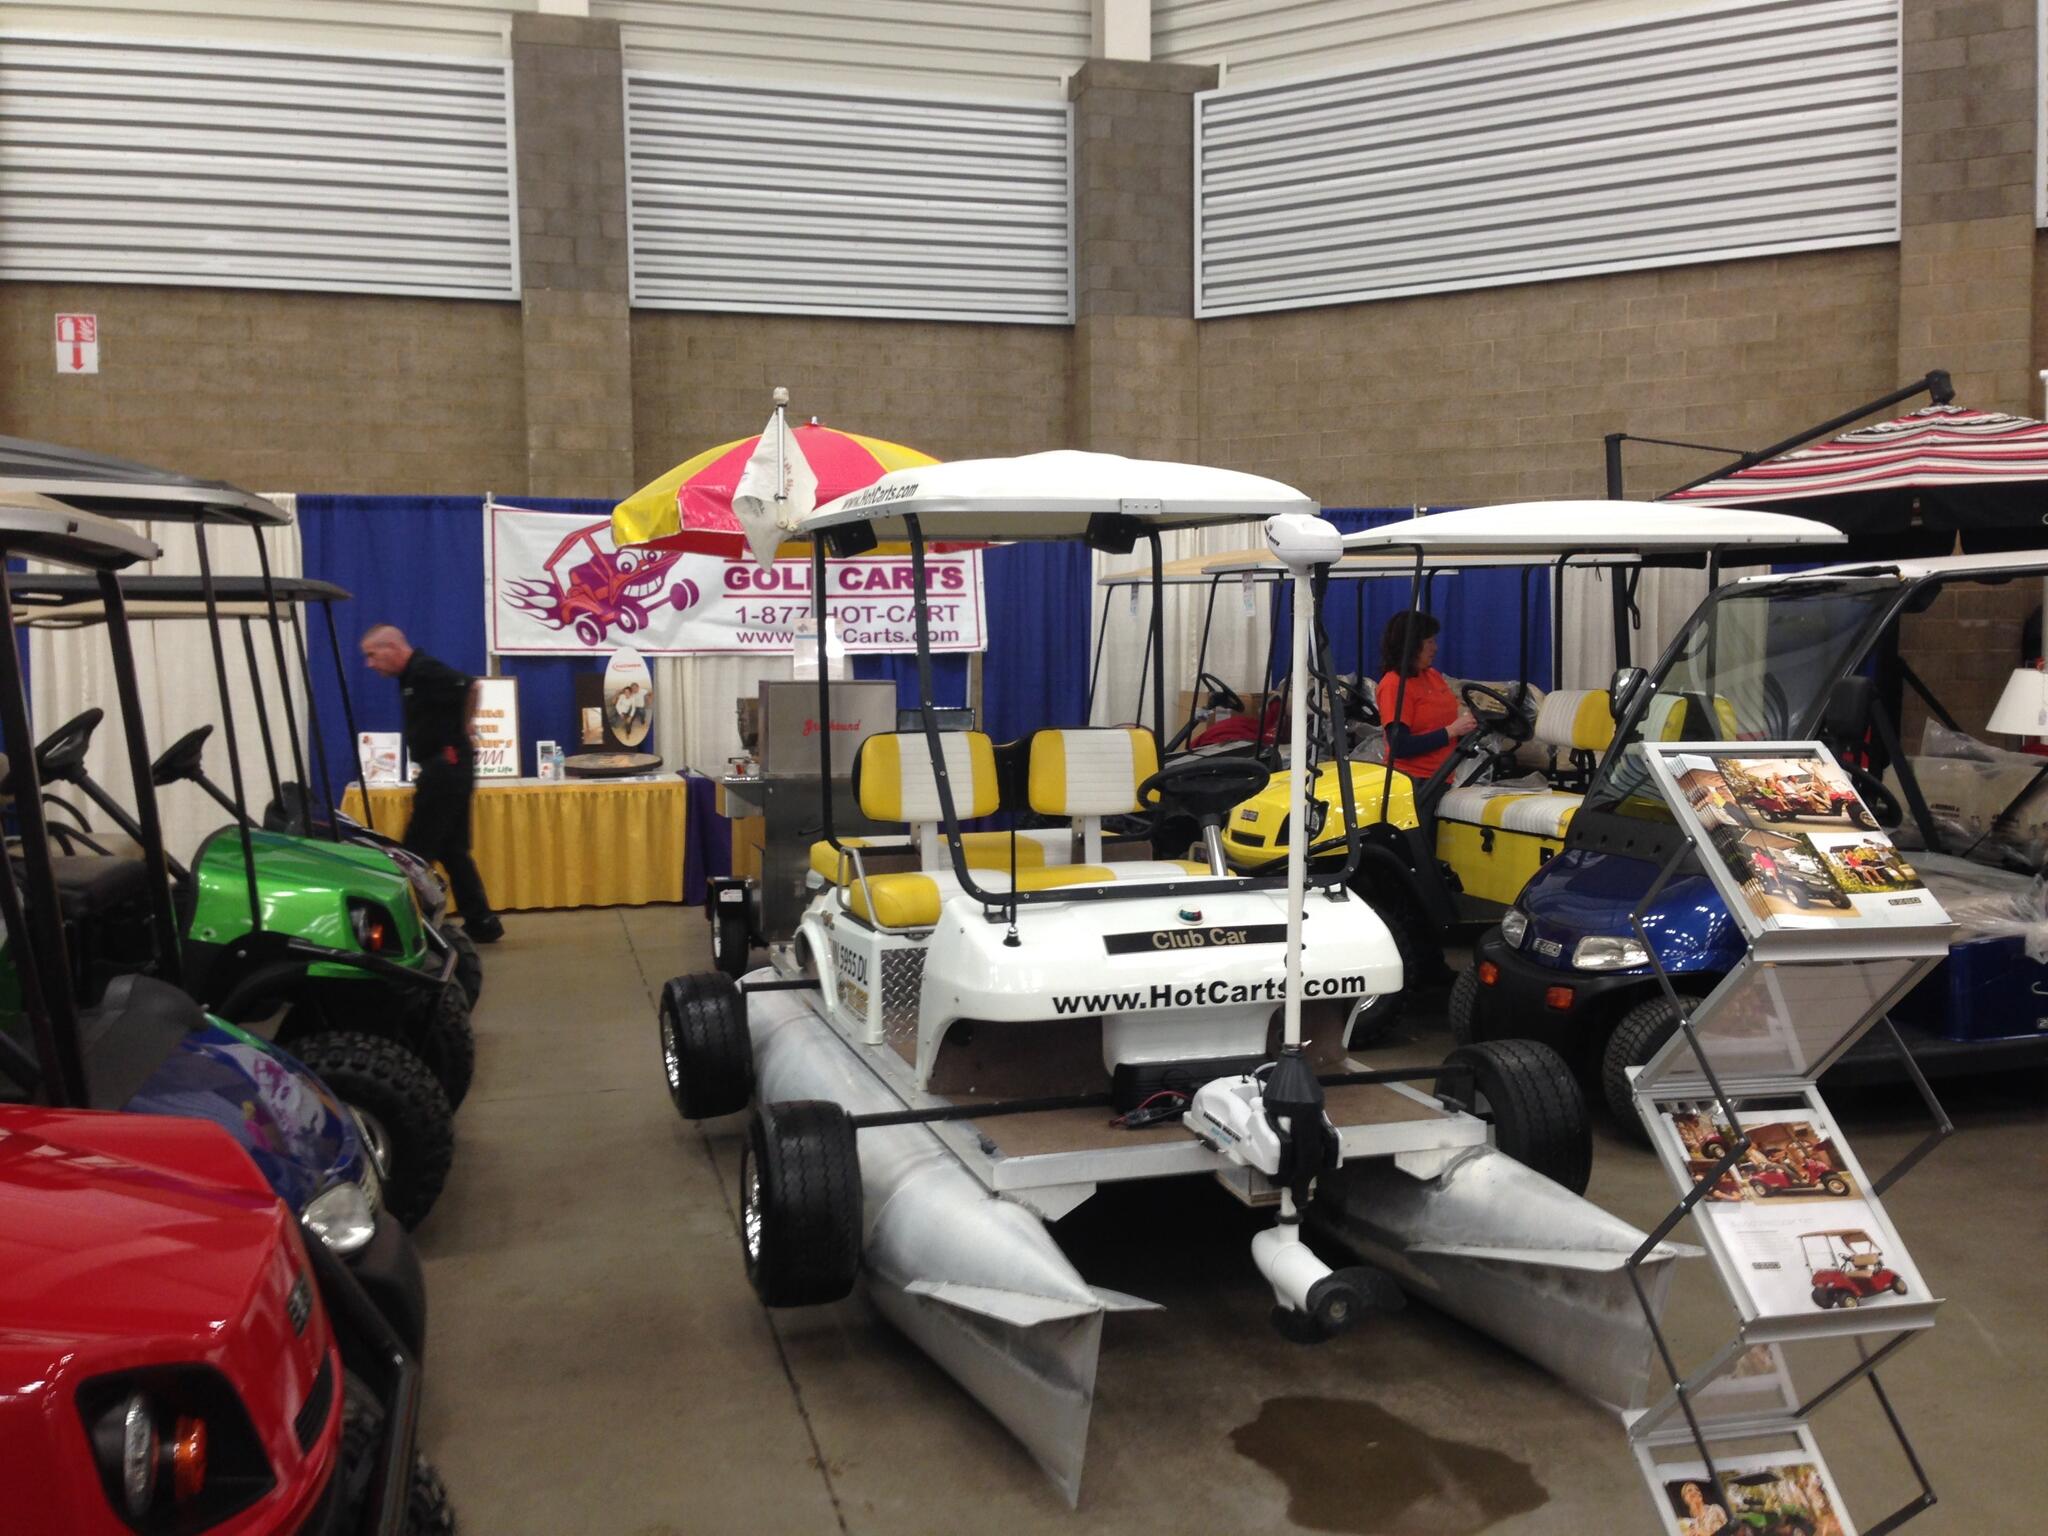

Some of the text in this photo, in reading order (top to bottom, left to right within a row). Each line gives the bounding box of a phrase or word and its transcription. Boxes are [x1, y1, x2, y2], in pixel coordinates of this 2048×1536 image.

[838, 566, 964, 591] CARTS
[1152, 928, 1248, 950] Club Car
[1052, 975, 1366, 1015] www.HotCartscom
